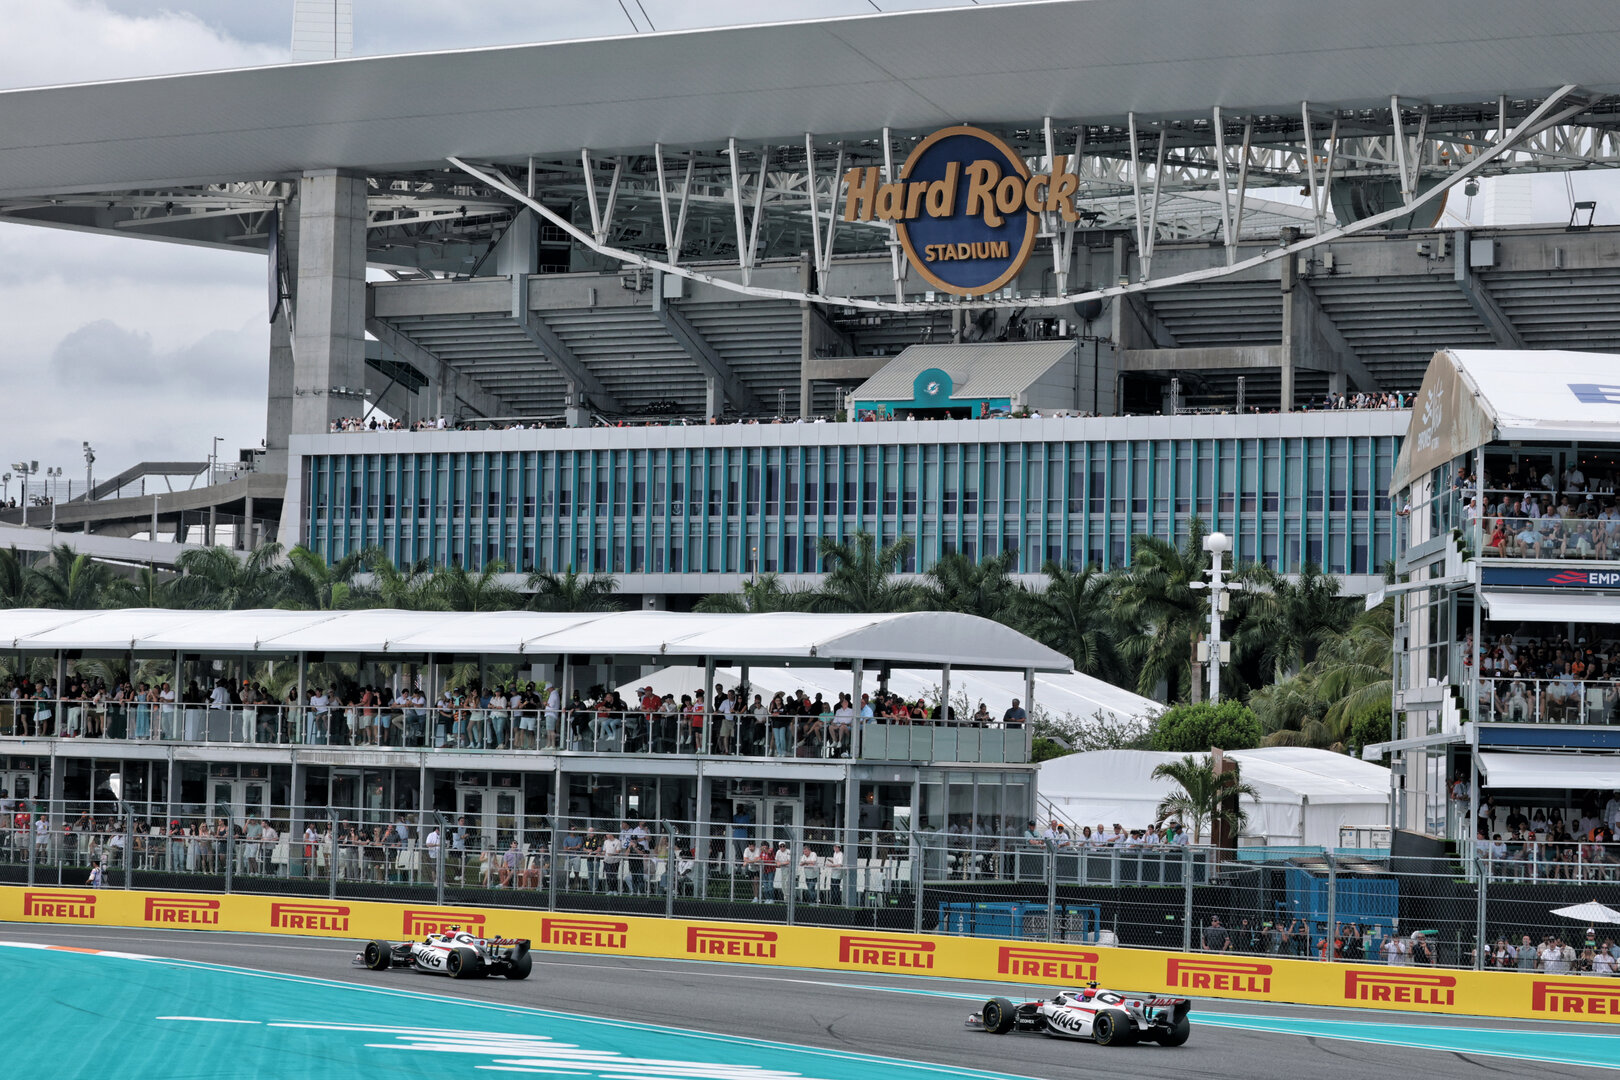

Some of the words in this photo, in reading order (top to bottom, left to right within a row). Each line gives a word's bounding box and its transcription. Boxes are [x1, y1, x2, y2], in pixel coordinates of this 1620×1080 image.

[843, 161, 960, 222] Hard
[965, 155, 1080, 228] Rock
[924, 241, 1009, 262] STADIUM
[24, 893, 96, 918] PIRELLI
[145, 898, 220, 923] PIRELLI
[271, 903, 350, 931] PIRELLI
[403, 910, 486, 938] PIREI
[542, 919, 628, 948] PIRELLI
[687, 927, 777, 957] PIRELLI
[839, 936, 935, 968] PIRELLI
[998, 947, 1098, 980] PIRELLI
[1167, 959, 1272, 992] PIRELLI
[1345, 971, 1456, 1005] PIRELLI
